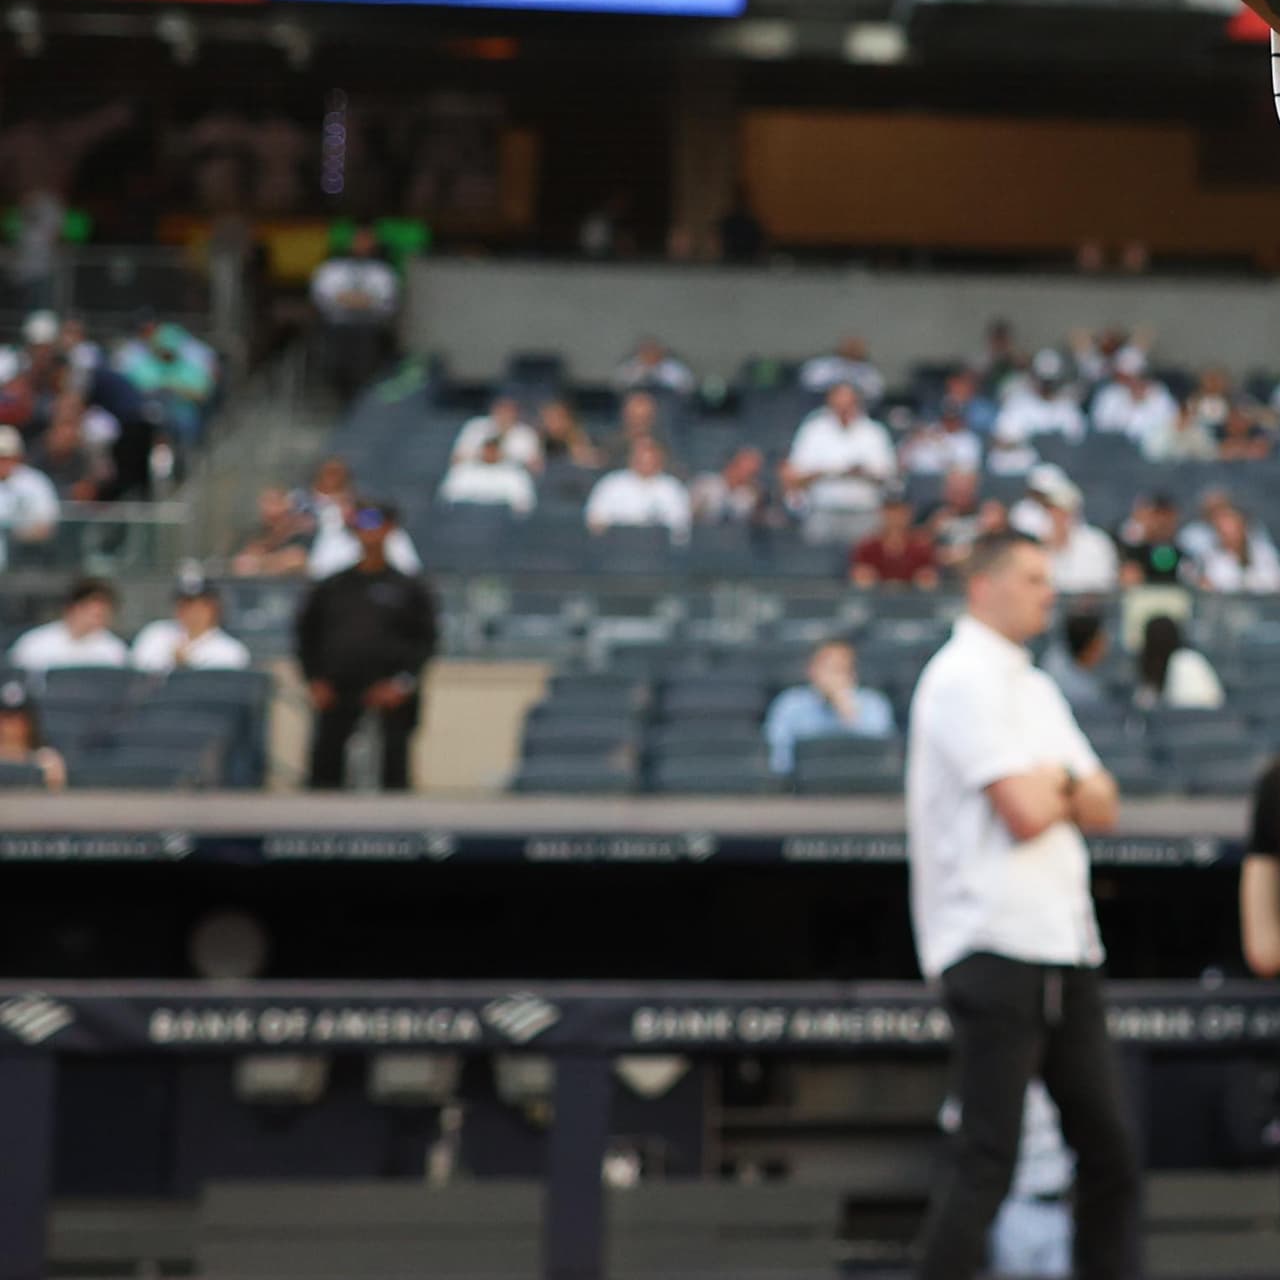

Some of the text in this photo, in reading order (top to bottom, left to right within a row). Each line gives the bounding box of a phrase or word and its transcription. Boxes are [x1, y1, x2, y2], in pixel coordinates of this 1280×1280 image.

[150, 1007, 483, 1044] BANK OF AMERICA
[631, 1006, 954, 1043] BANK OF AMERICA
